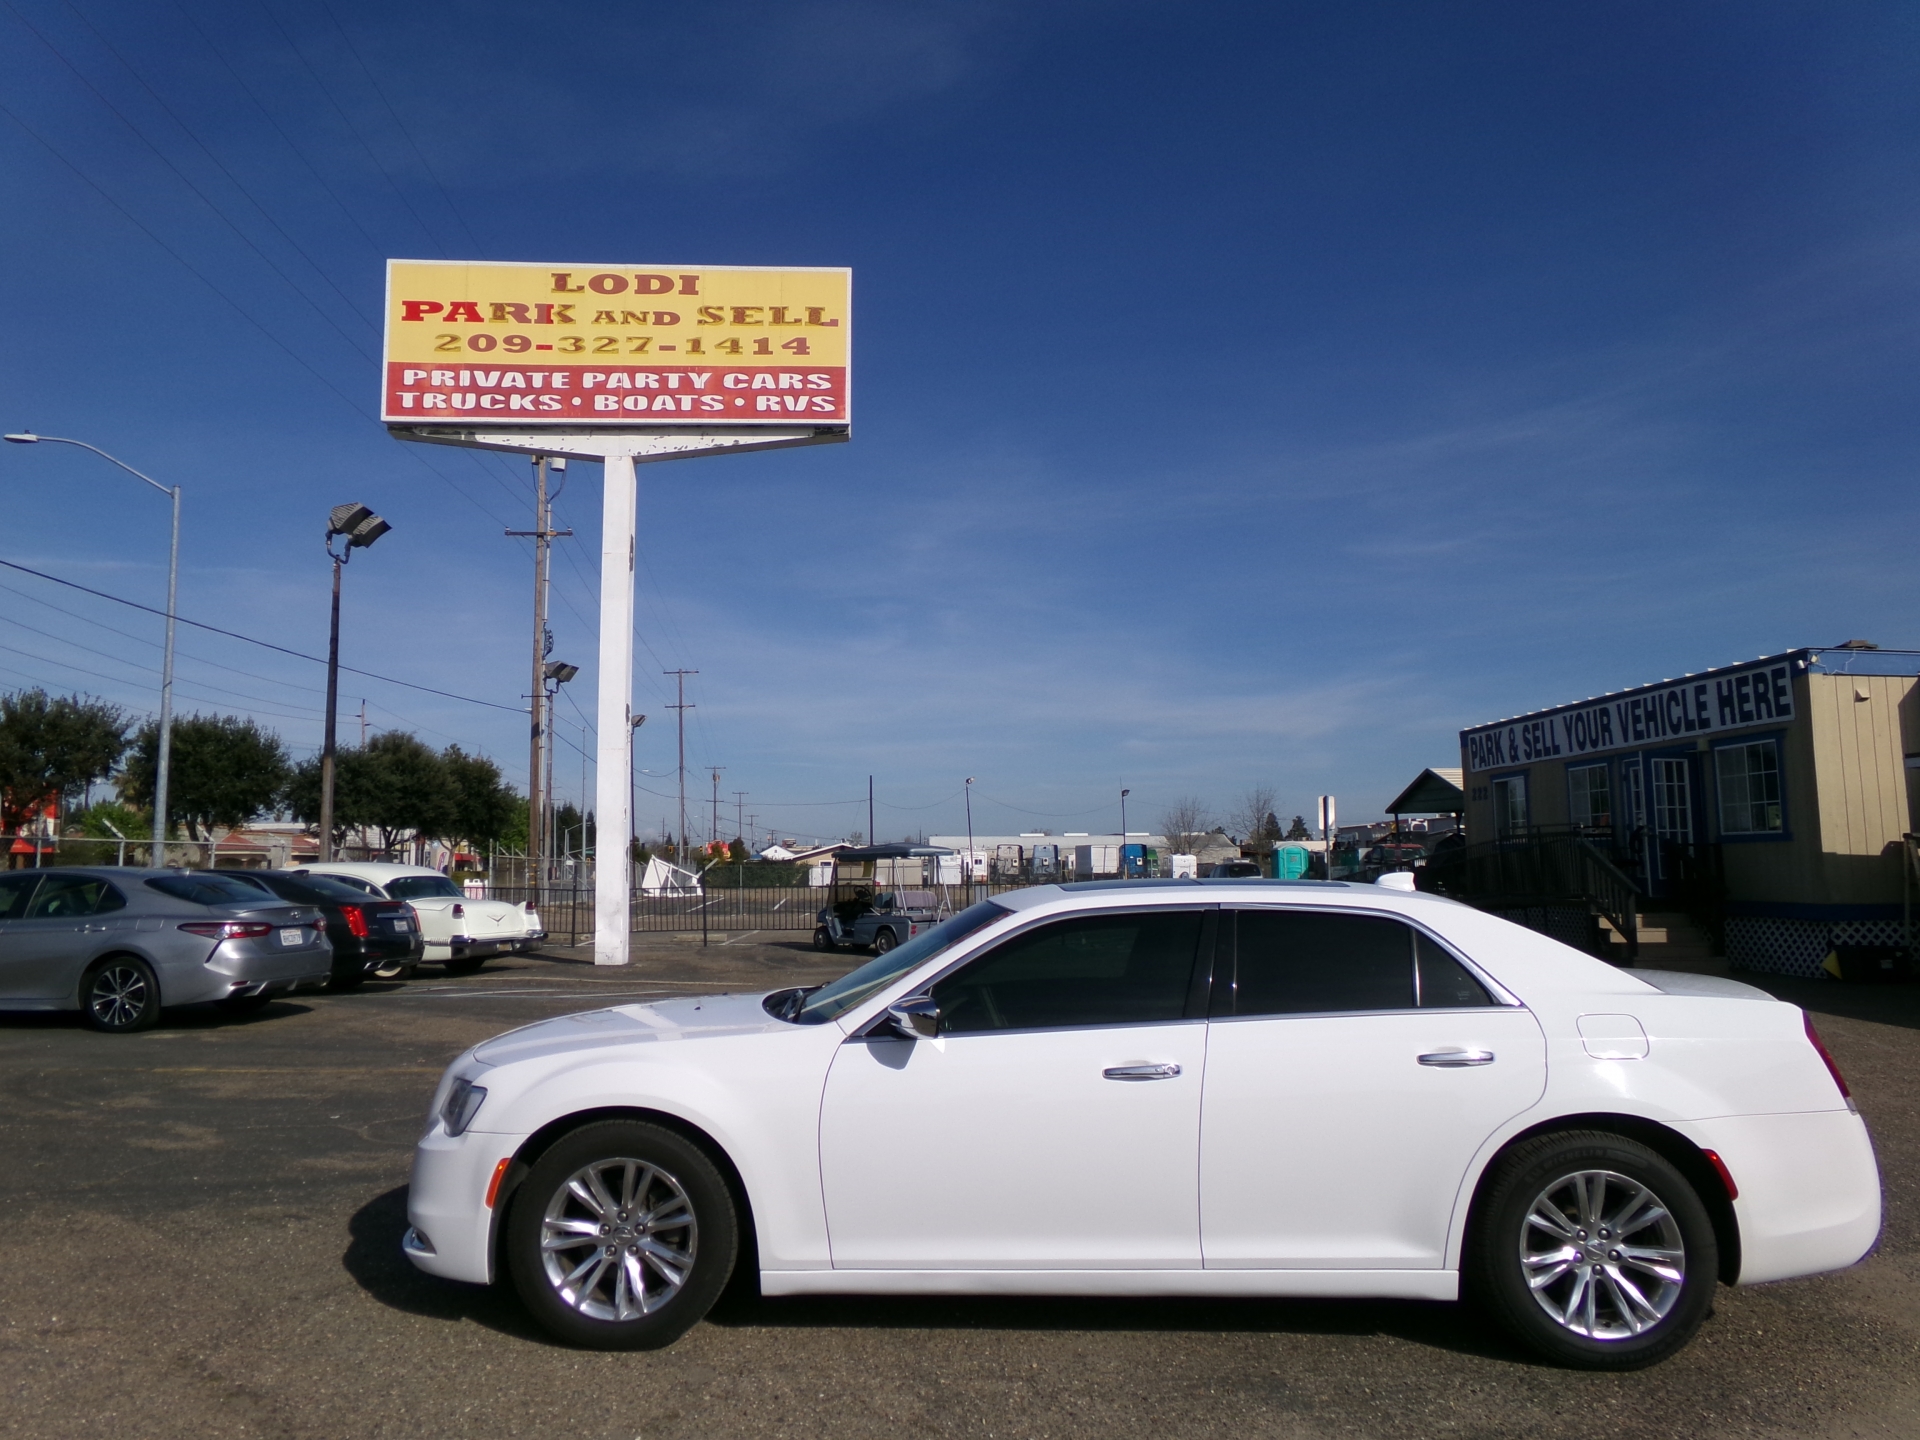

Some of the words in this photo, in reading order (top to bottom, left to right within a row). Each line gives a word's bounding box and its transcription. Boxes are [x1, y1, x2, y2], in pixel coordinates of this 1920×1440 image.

[551, 272, 700, 295] LODI
[401, 300, 577, 325] PARK
[591, 310, 681, 326] AND
[696, 305, 839, 327] SELL
[434, 333, 811, 355] 209-327-1414
[403, 369, 570, 389] PRIVATE
[582, 372, 713, 389] PARTY
[723, 372, 833, 390] CARS
[395, 392, 563, 411] TRUCKS
[594, 394, 725, 411] BOATS
[756, 395, 836, 412] RVS
[1470, 730, 1505, 769] PARK
[1508, 727, 1520, 764] &
[1522, 719, 1560, 760] SELL
[1563, 707, 1614, 753] YOUR
[1616, 684, 1711, 743] VEHICLE
[1716, 667, 1792, 726] HERE
